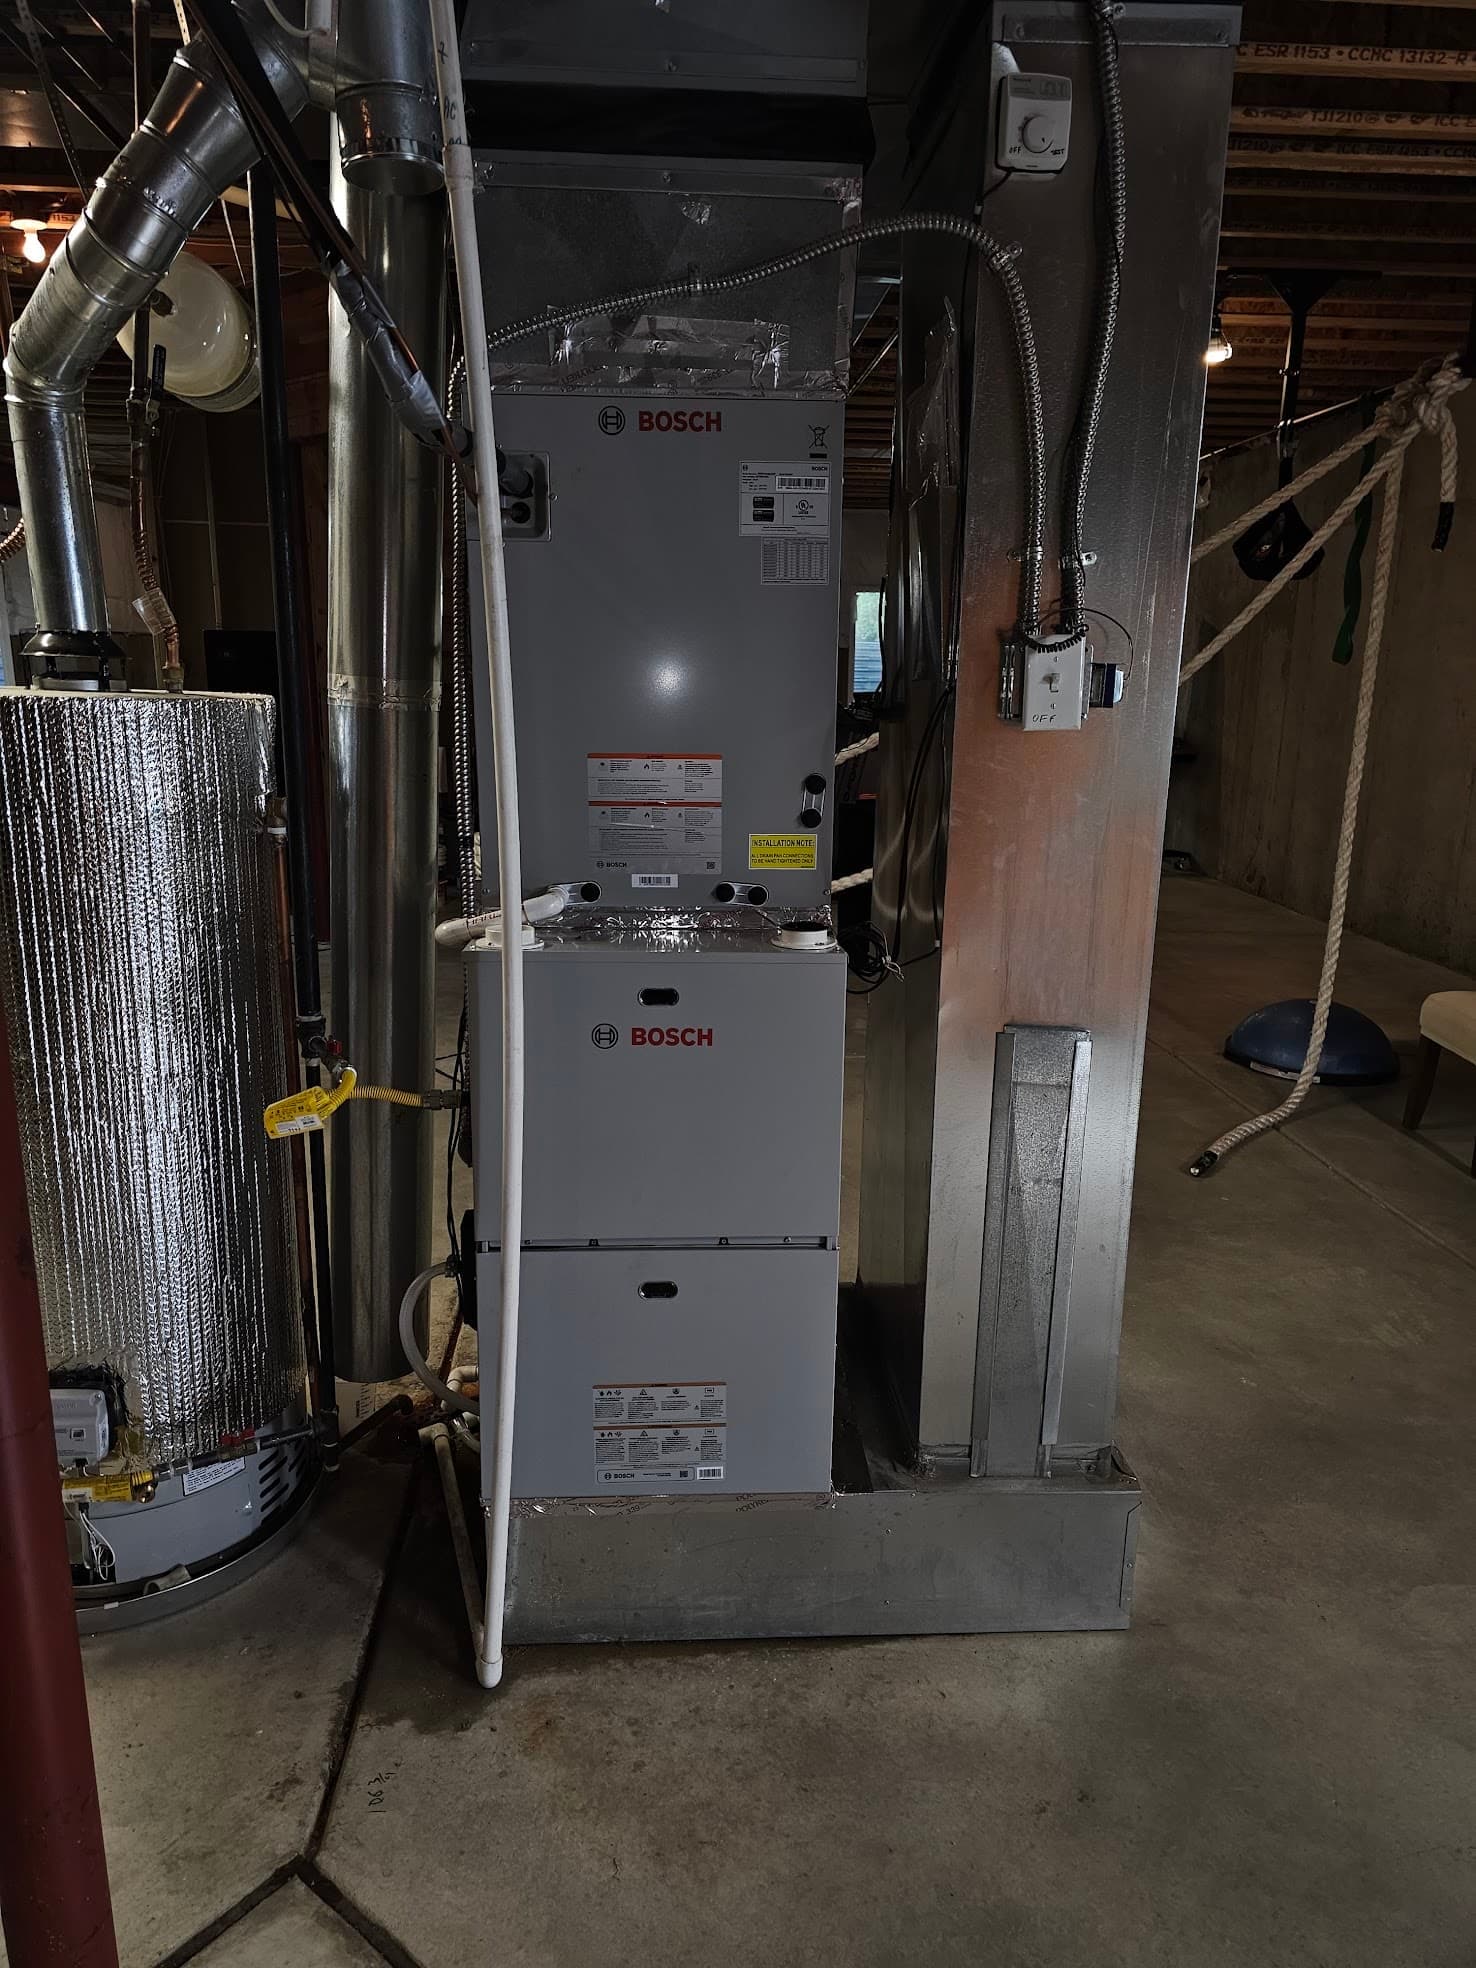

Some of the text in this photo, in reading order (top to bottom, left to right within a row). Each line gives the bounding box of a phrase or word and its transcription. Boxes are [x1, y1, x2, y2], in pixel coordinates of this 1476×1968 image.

[1254, 44, 1289, 58] ESR
[1294, 45, 1331, 59] 1153
[1348, 47, 1393, 62] CCMC
[1399, 50, 1468, 65] 13132-R
[1434, 114, 1461, 127] ICC
[639, 411, 723, 433] BOSCH
[1032, 714, 1057, 723] OFF
[752, 839, 795, 847] INSTALLATION
[606, 861, 627, 869] BOSCH
[631, 1027, 714, 1048] BOSCH
